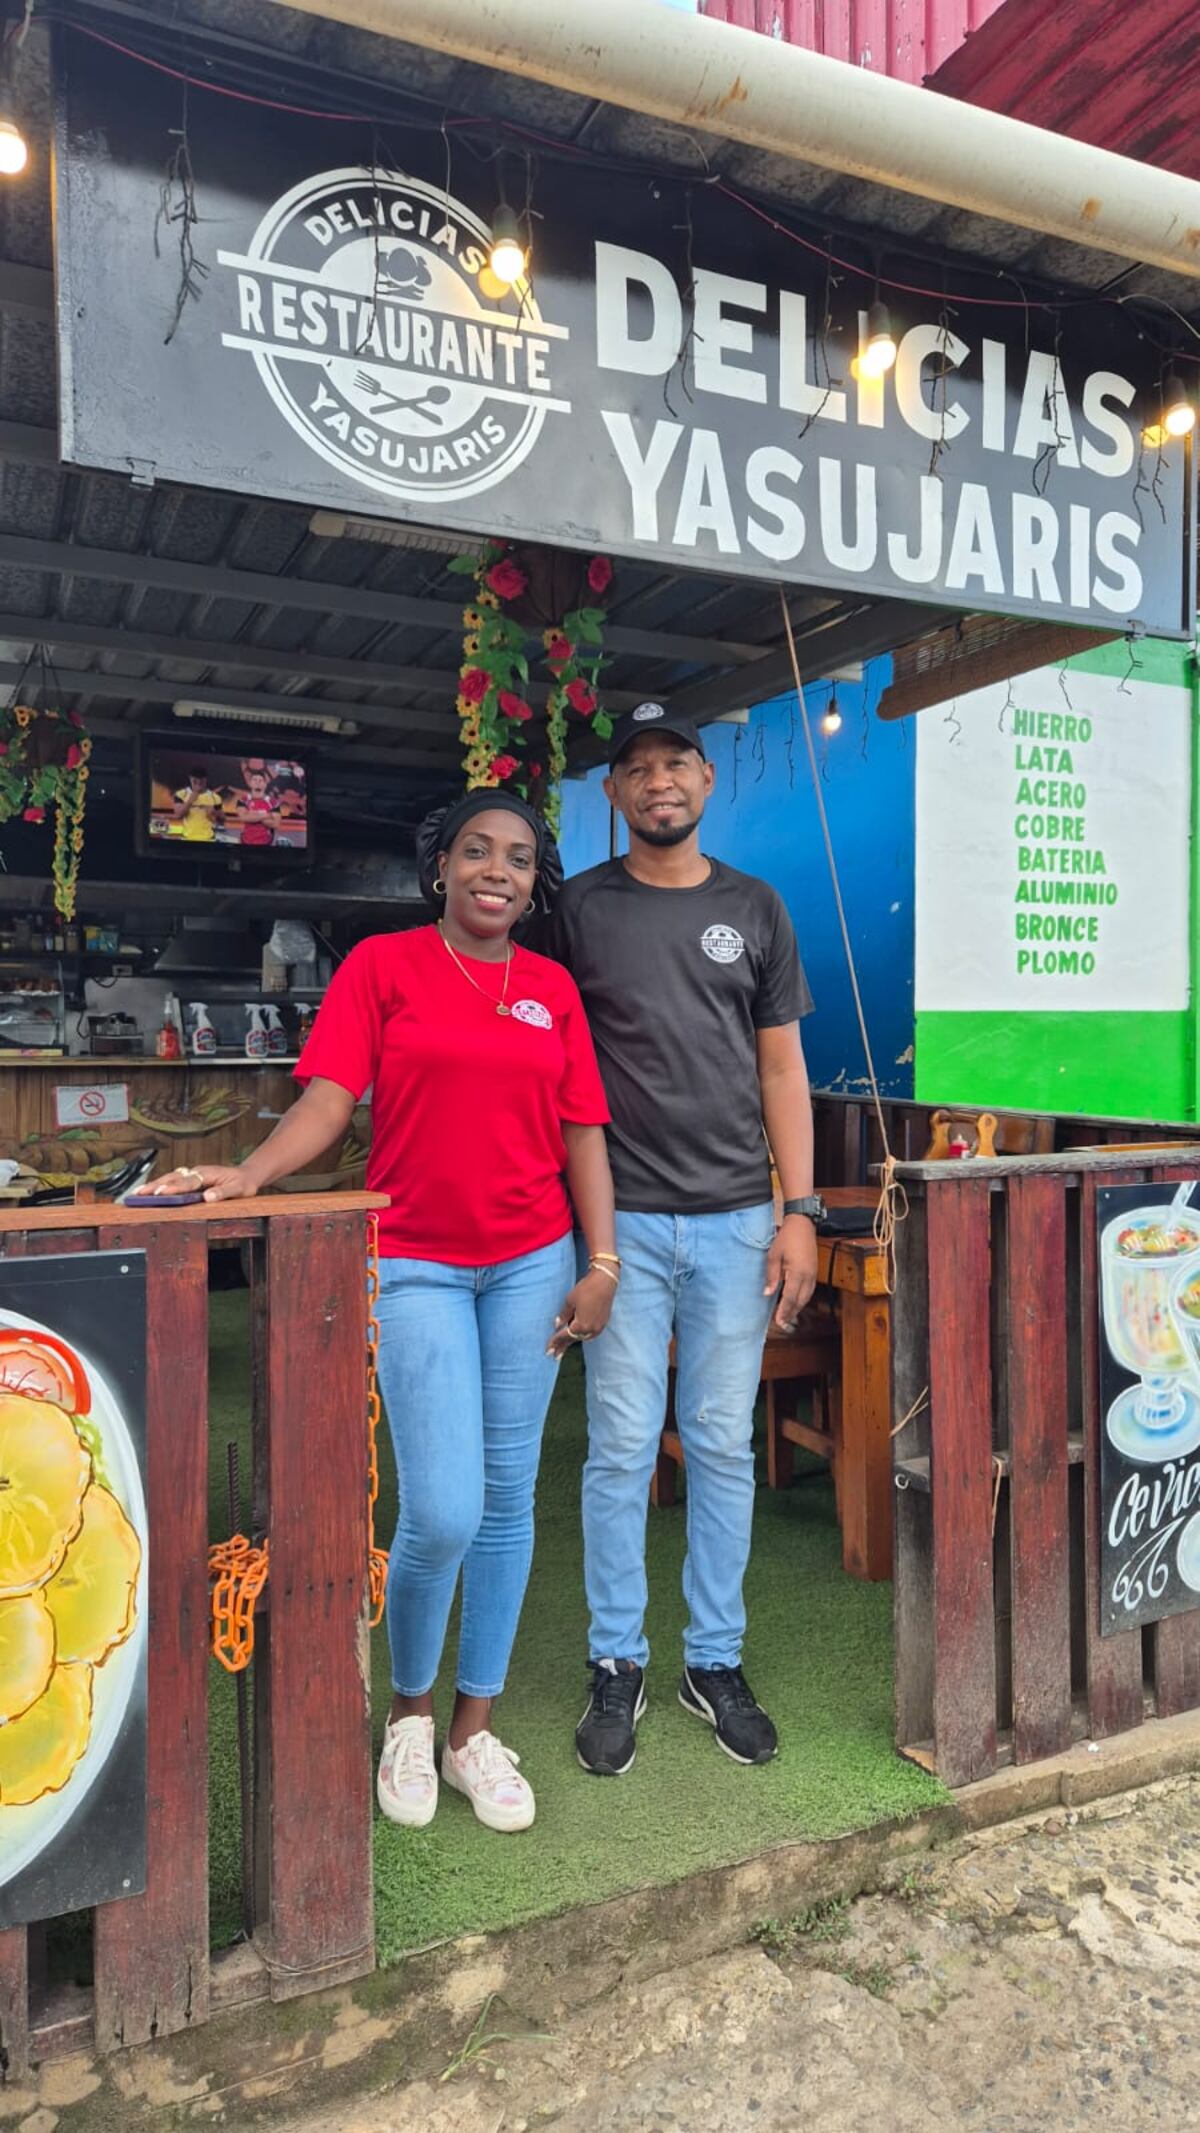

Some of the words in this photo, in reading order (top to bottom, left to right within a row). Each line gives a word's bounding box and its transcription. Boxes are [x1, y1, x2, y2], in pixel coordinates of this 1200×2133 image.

[304, 197, 488, 276] DELICIAS
[238, 274, 551, 391] RESTAURANTE
[595, 241, 1136, 477] DELICIAS
[309, 382, 506, 473] YASUJARIS
[601, 410, 1144, 613] YASUJARIS
[1013, 709, 1092, 743] HIERRO
[1015, 745, 1073, 774] LATA
[1015, 778, 1086, 809] ACERO
[1014, 814, 1085, 841] COBRE
[1018, 846, 1106, 874] BATERIA
[1014, 880, 1118, 905] ALUMINIO
[1015, 913, 1098, 942] BRONCE
[1017, 950, 1095, 975] PLOMO
[1108, 1458, 1200, 1547] Cevic
